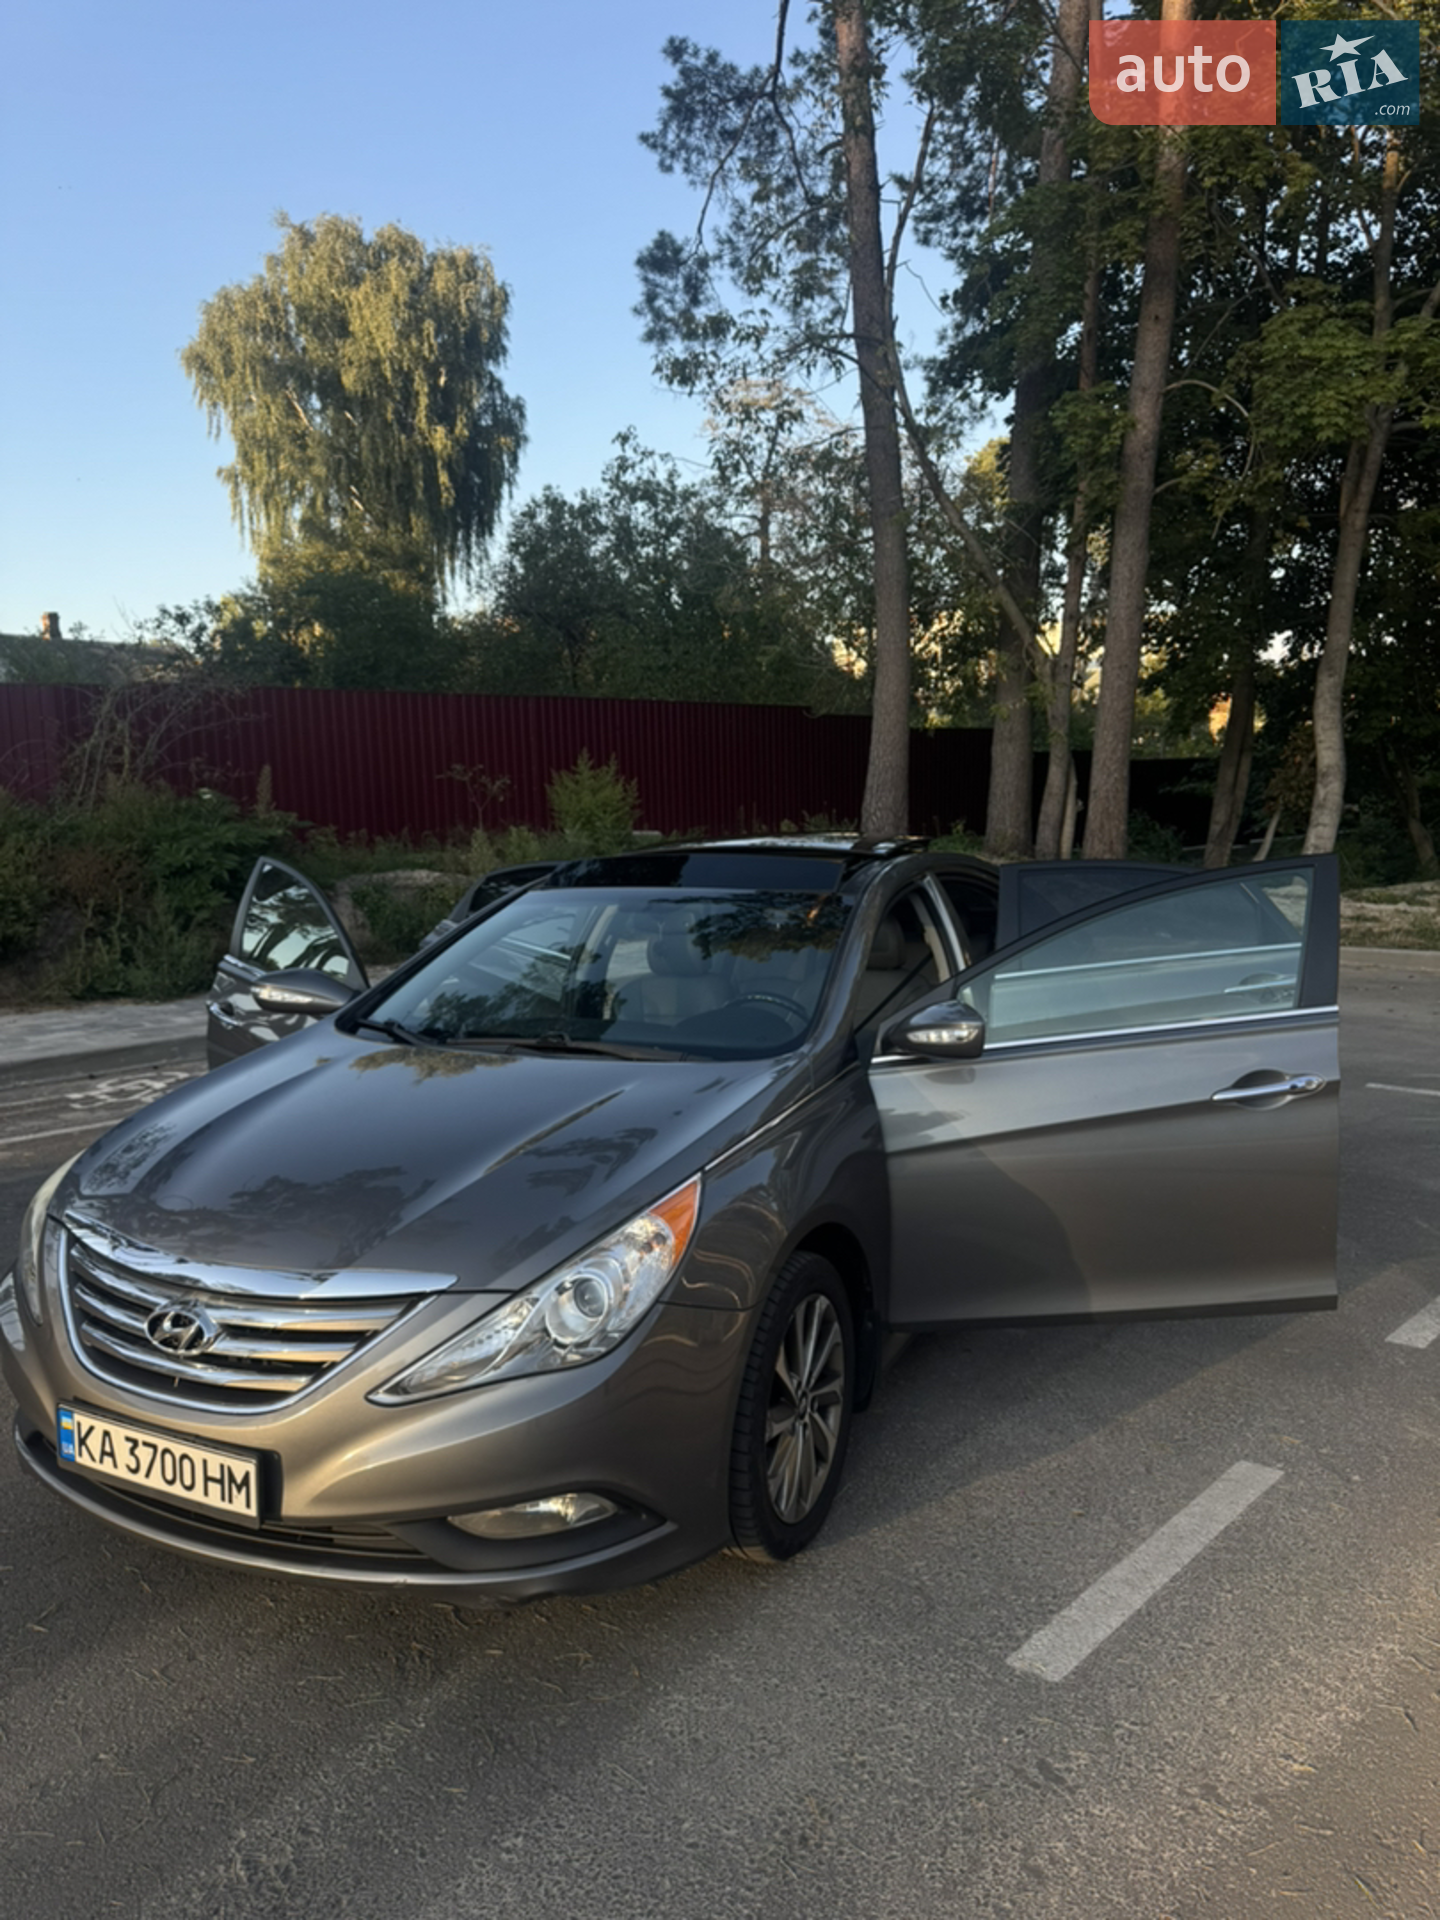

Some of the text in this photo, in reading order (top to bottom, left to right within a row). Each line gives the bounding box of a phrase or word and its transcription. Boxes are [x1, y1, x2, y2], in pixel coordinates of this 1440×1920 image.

[77, 1421, 251, 1510] KA 3700 HM
